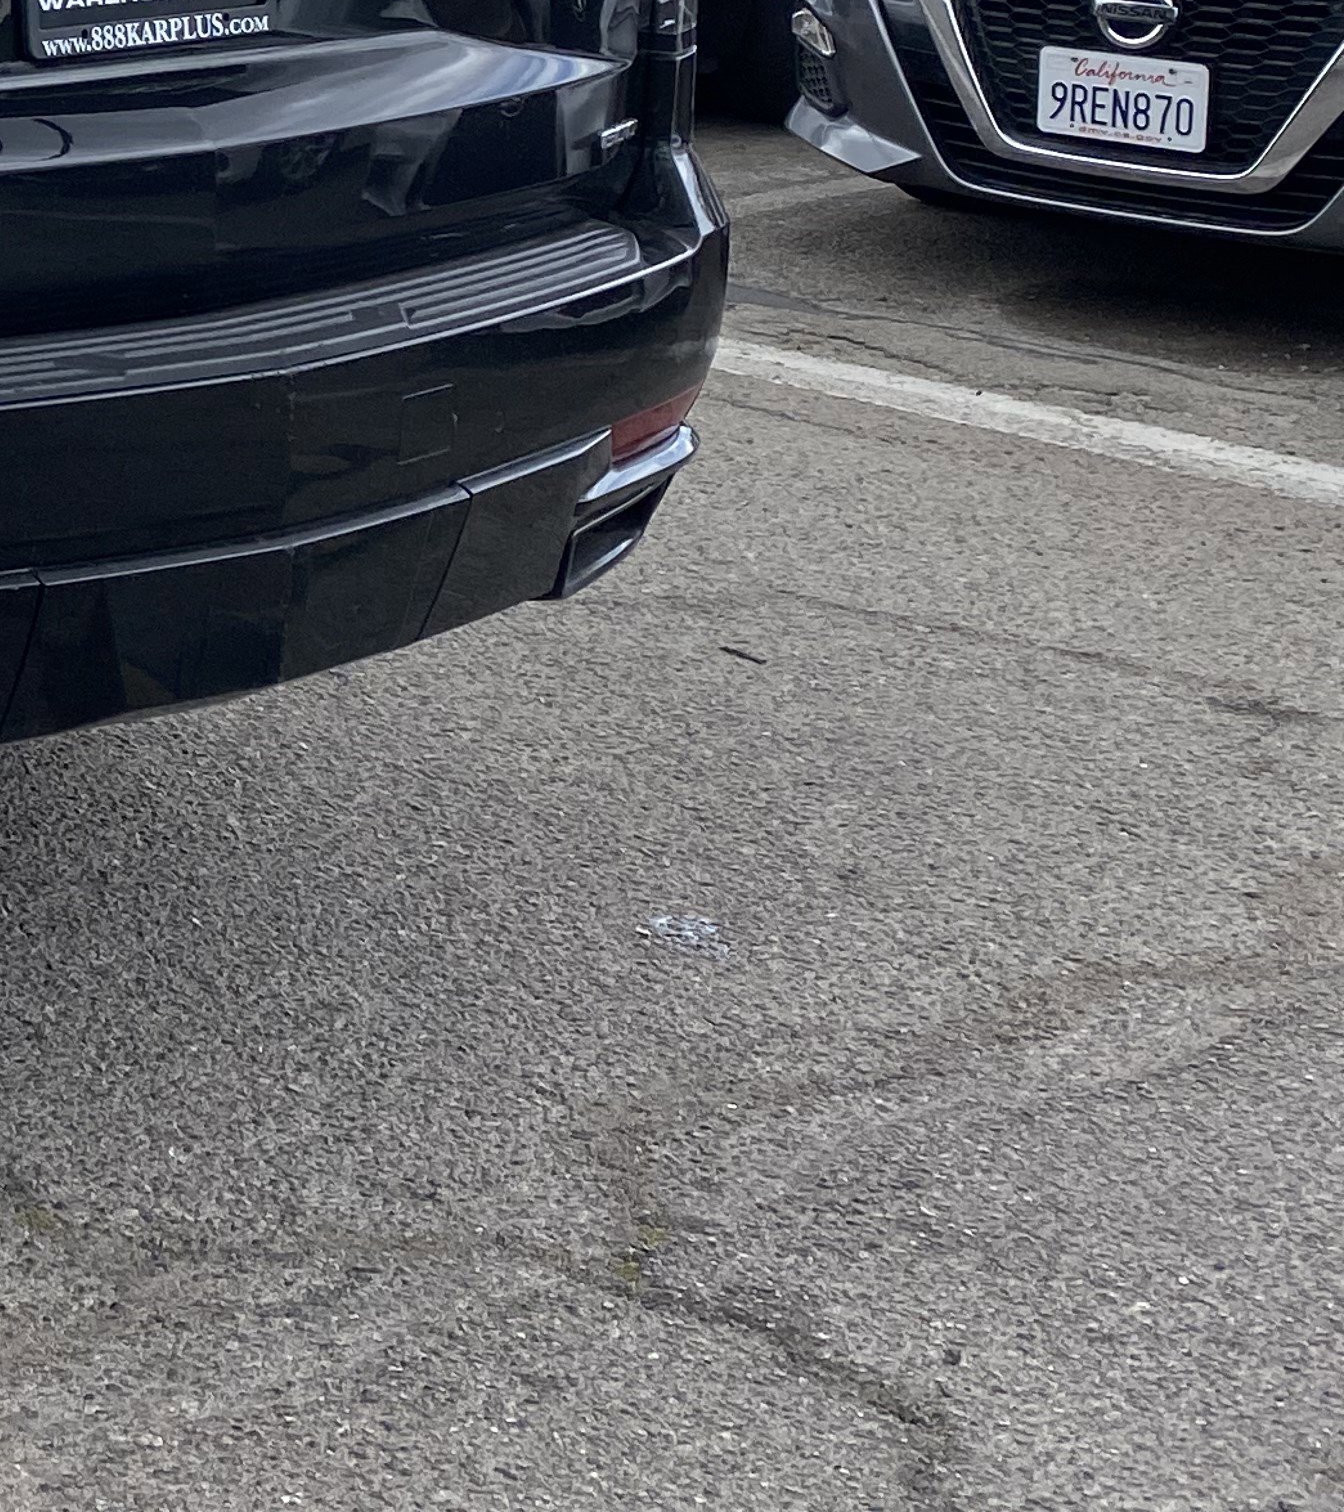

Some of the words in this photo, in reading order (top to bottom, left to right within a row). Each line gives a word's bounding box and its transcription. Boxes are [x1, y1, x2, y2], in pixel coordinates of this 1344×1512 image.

[1101, 3, 1166, 20] NISSAN
[1075, 57, 1176, 86] California
[1049, 81, 1194, 136] 9REN870
